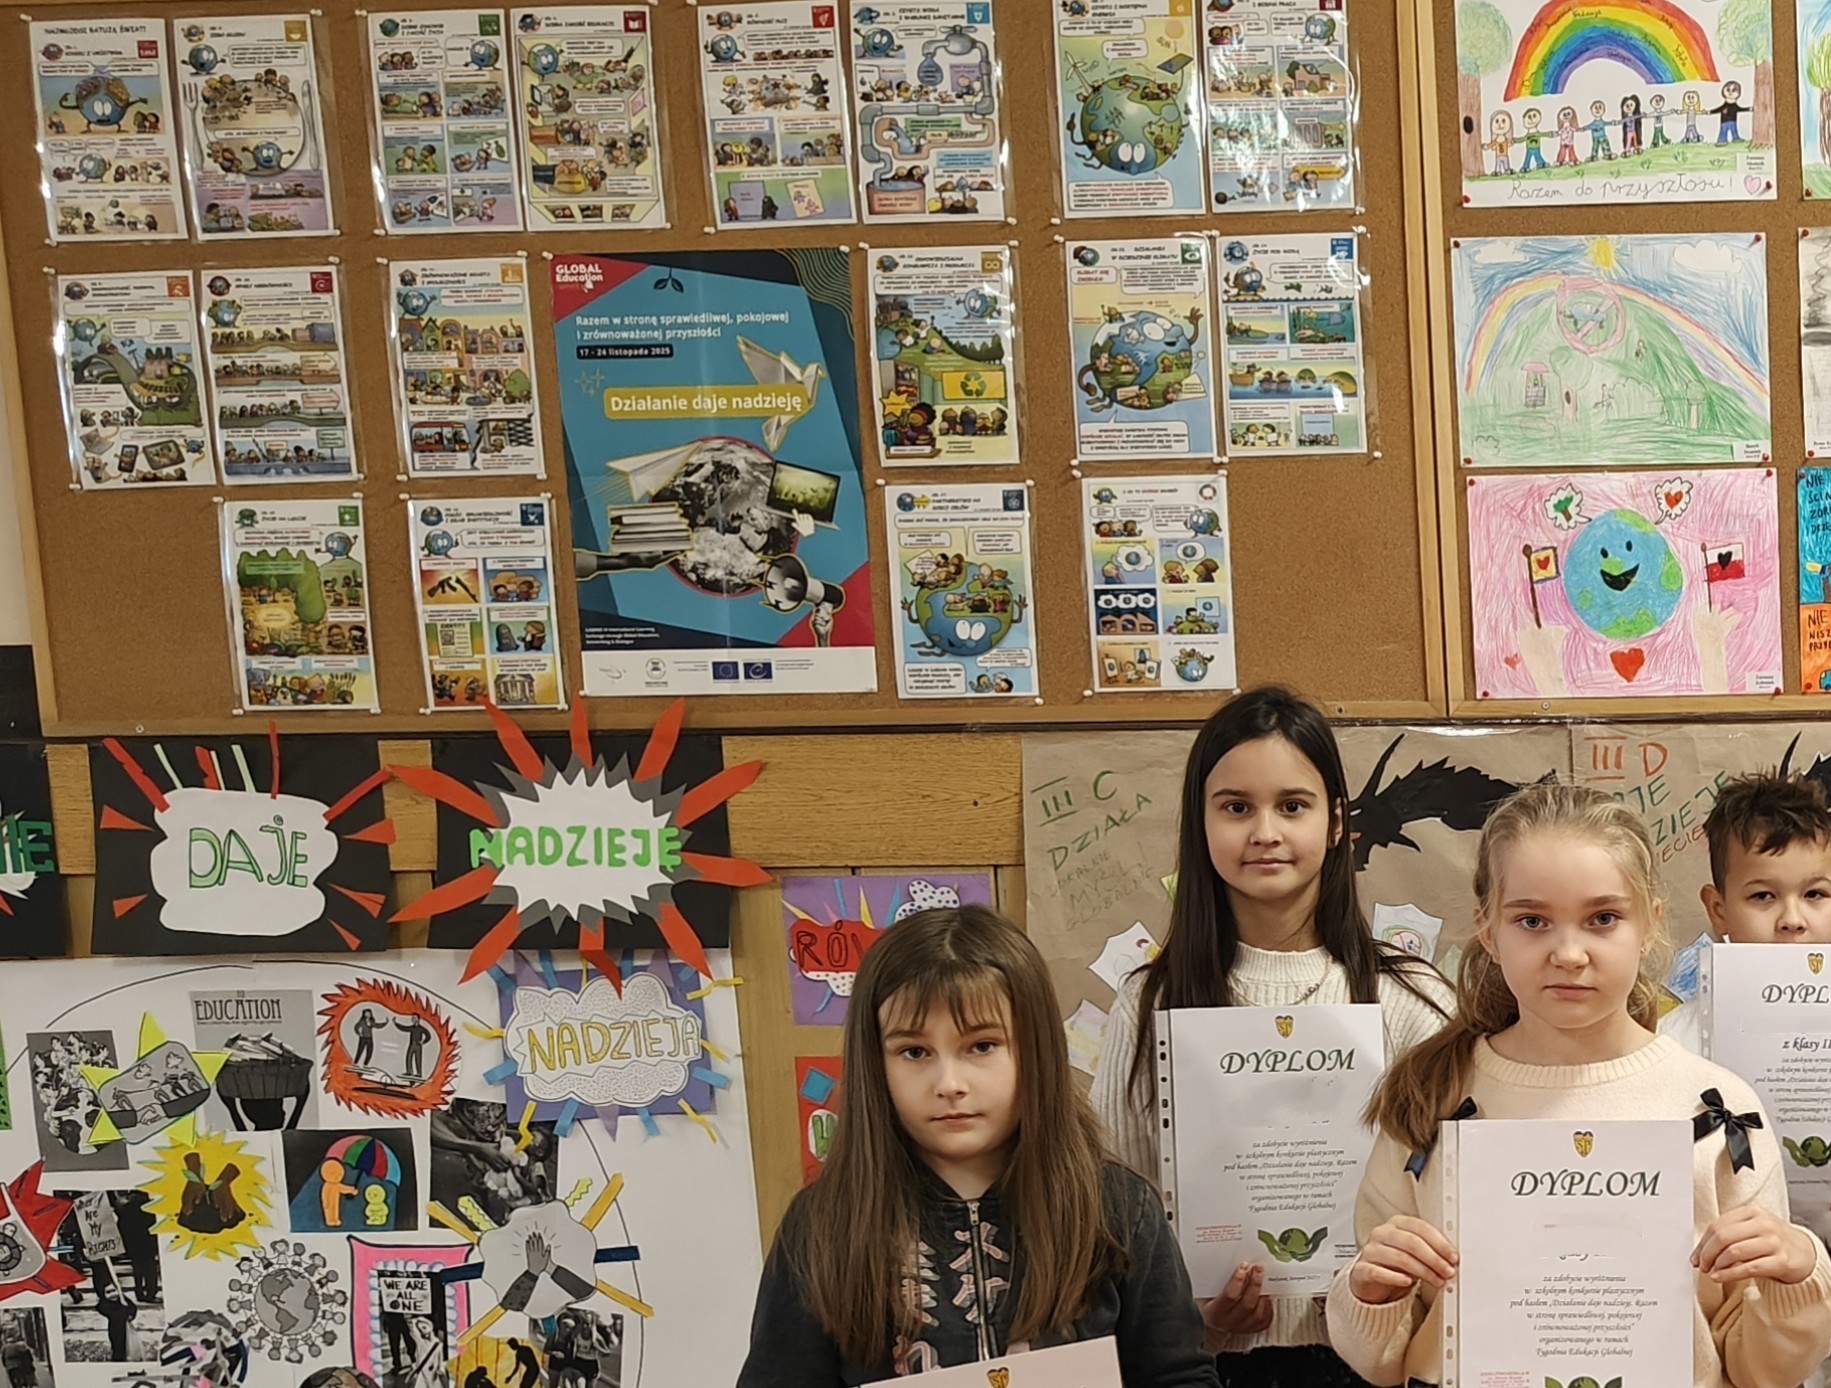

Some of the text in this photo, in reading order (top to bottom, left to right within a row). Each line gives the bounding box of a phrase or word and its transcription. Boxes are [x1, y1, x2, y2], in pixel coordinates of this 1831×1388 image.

[1508, 180, 1593, 199] Razem do
[556, 264, 602, 274] GLOBAL
[556, 273, 603, 283] Education
[576, 315, 609, 325] Razem
[623, 315, 658, 327] stronę
[660, 313, 733, 327] sprawiedliwej,
[736, 312, 789, 325] pokojowej
[583, 329, 662, 342] zrównoważonej
[665, 327, 721, 340] przyszłości
[579, 346, 670, 358] 17 24 listopada 2025
[611, 393, 802, 413] Działanie daje nadzieję
[1806, 475, 1825, 487] NIE
[1808, 609, 1828, 628] NIE
[1584, 736, 1669, 784] III D
[1047, 793, 1152, 871] DZIAŁA
[188, 814, 309, 889] DAJE
[469, 825, 684, 873] NADZIEJĘ
[194, 998, 282, 1022] EDUCATION
[527, 1013, 700, 1074] NADZIEJA
[1782, 1039, 1790, 1050] z
[1793, 1037, 1820, 1053] klasy
[1220, 1048, 1356, 1074] DYPLOM
[1510, 1169, 1661, 1197] DYPLOM
[384, 1279, 429, 1291] WE ARE
[396, 1290, 417, 1301] ALL
[389, 1298, 424, 1313] ONE
